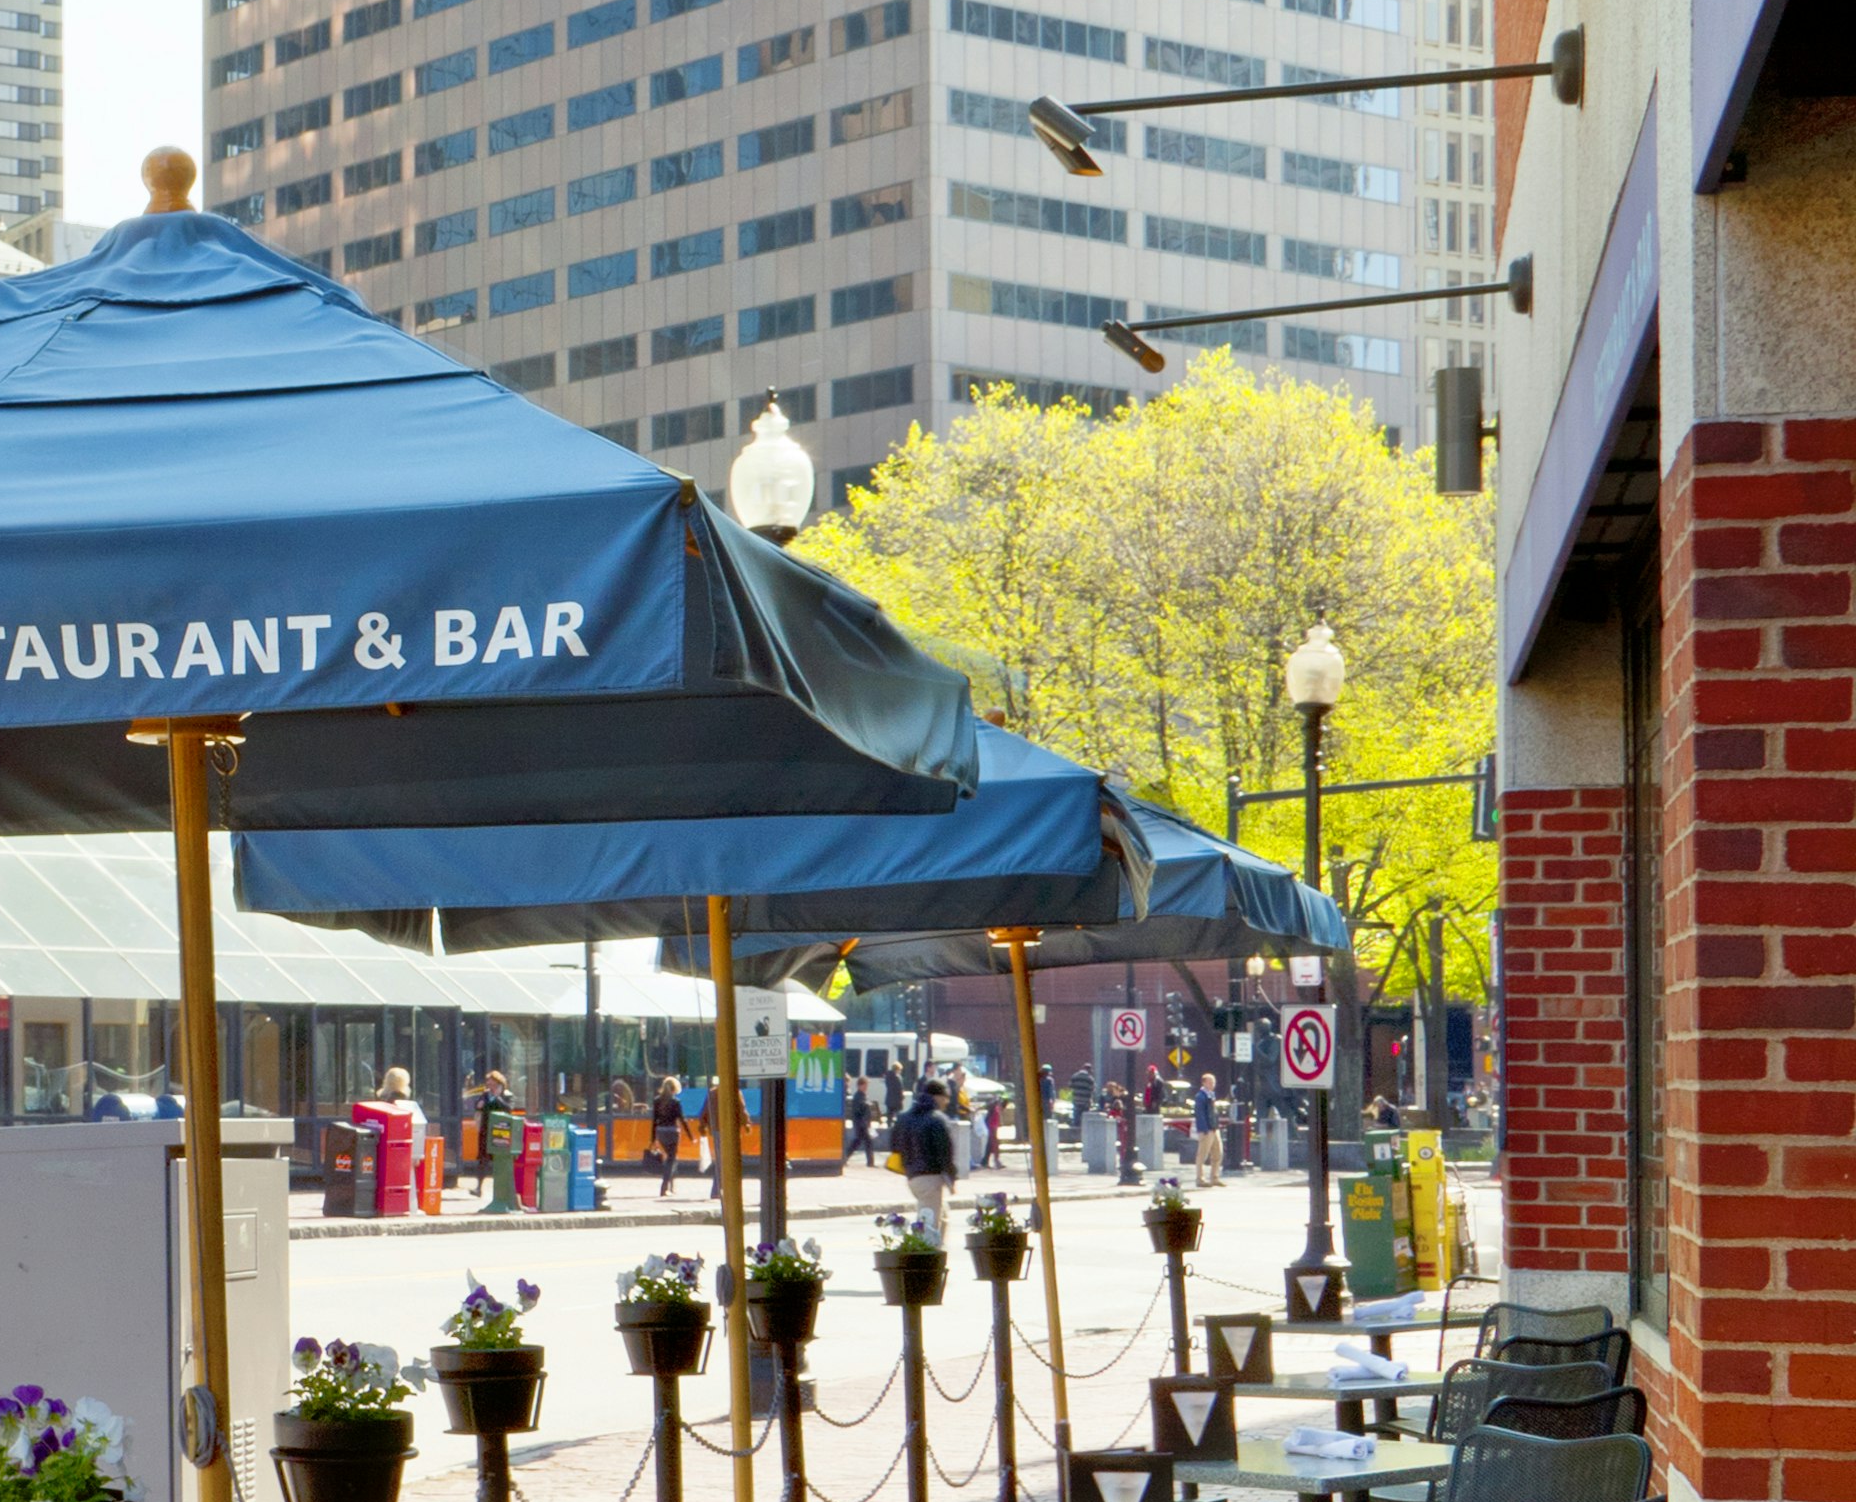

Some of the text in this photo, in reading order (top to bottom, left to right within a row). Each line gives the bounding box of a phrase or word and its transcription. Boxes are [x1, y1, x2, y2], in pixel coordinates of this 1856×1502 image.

[354, 612, 406, 670] &
[434, 601, 589, 666] BAR
[1348, 1194, 1384, 1206] Boston
